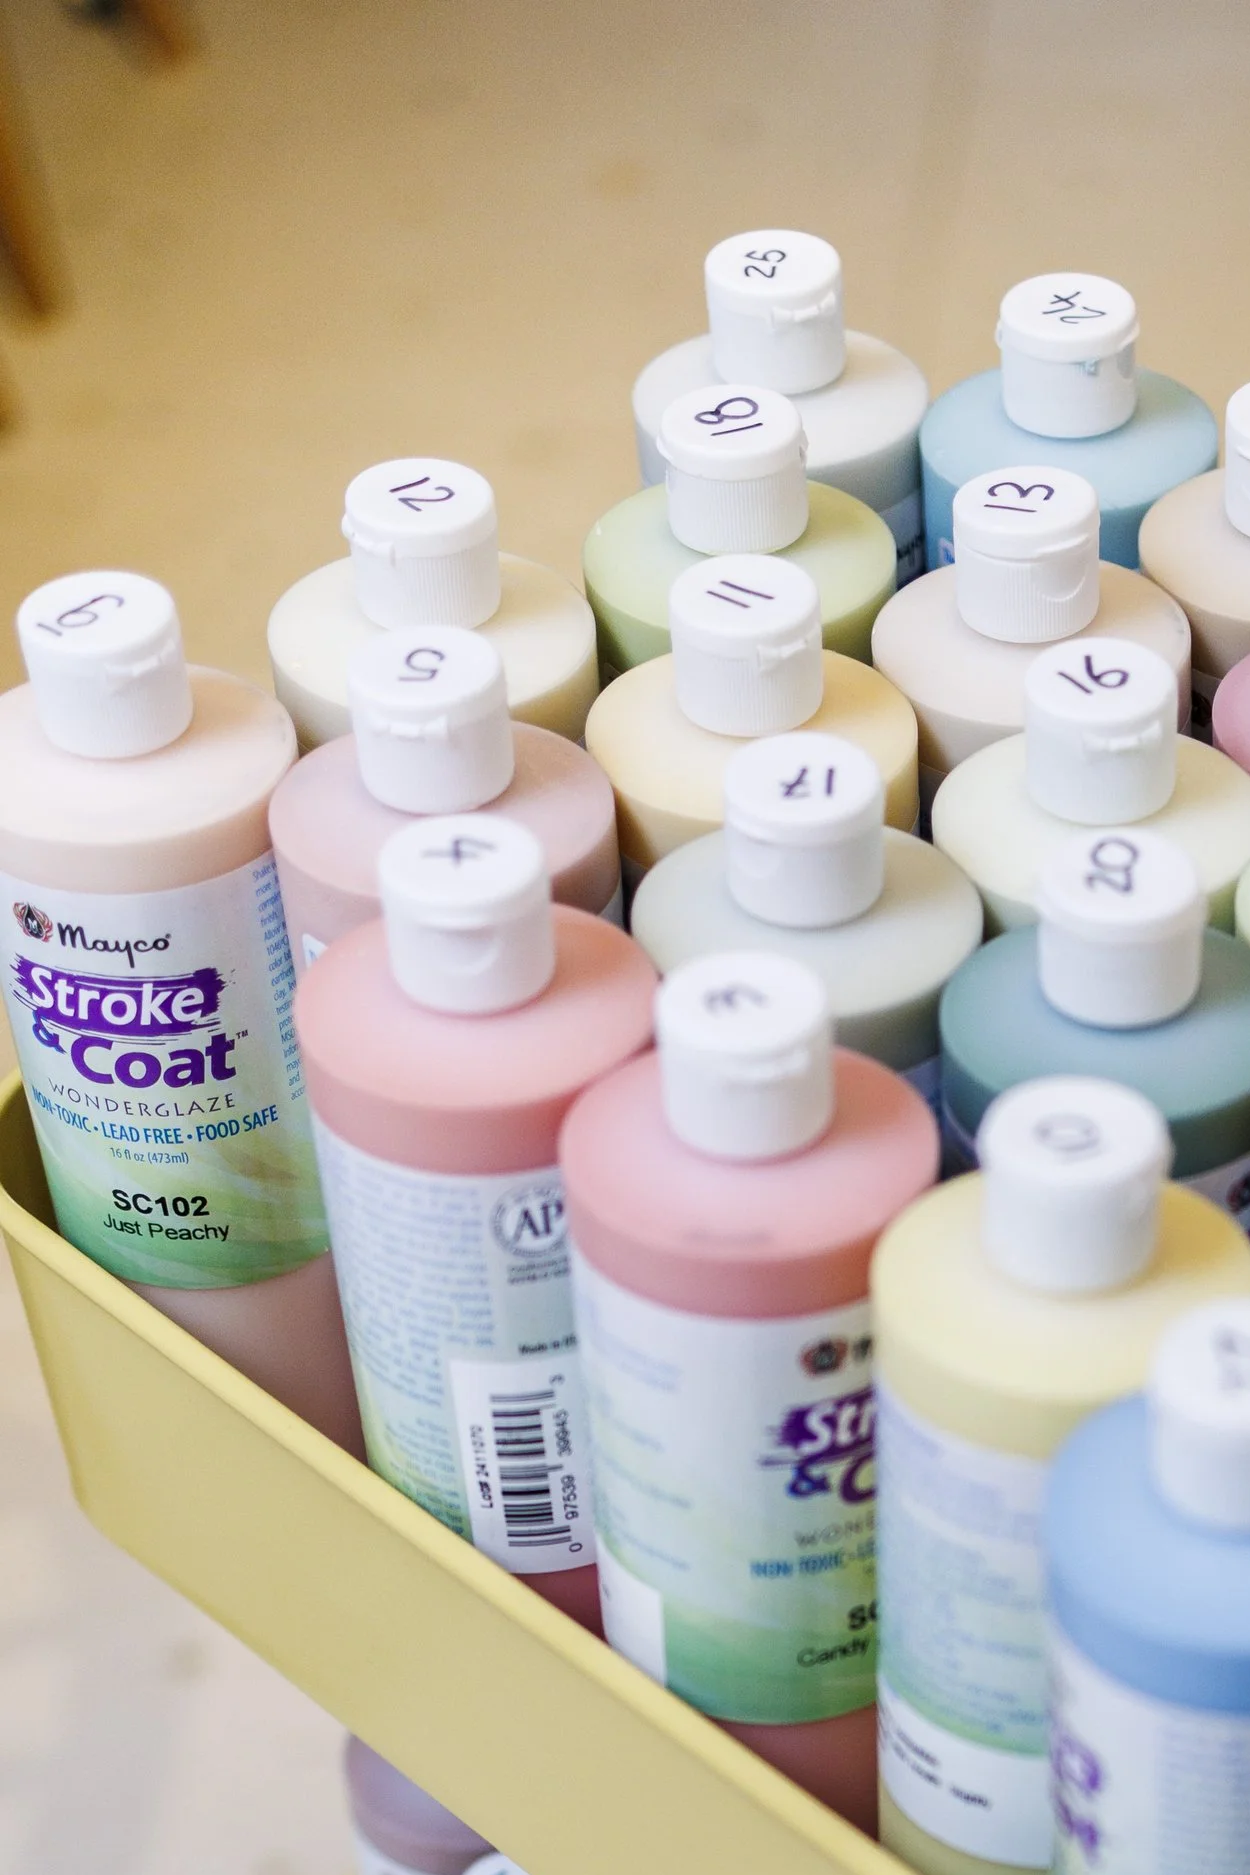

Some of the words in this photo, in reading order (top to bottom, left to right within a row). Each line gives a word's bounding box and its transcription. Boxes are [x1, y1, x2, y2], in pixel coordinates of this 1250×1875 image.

[744, 248, 787, 279] 25
[1042, 290, 1107, 324] 24
[695, 396, 763, 436] 18
[389, 476, 455, 512] 12
[984, 481, 1055, 513] 13
[706, 580, 775, 609] 11
[397, 647, 446, 683] 5
[1057, 654, 1129, 695] 16
[778, 765, 837, 798] 17
[421, 833, 497, 870] 4
[1085, 836, 1140, 893] 20
[56, 922, 171, 968] Mayco
[30, 966, 206, 1028] Stroke
[33, 1012, 67, 1054] &
[70, 1030, 238, 1089] Coat
[31, 1085, 92, 1132] NON-TOXIC
[102, 1121, 140, 1144] LEAD
[144, 1128, 184, 1145] FREE
[197, 1118, 240, 1142] FOOD
[244, 1104, 279, 1132] SAFE
[48, 1077, 236, 1118] WONDERGLAZE
[110, 1147, 122, 1159] 16
[124, 1148, 131, 1160] fl
[134, 1153, 144, 1162] oz
[148, 1152, 189, 1165] (473ml)
[111, 1189, 210, 1218] SC102
[102, 1213, 143, 1237] Just
[148, 1221, 230, 1242] Peachy
[511, 1198, 565, 1246] AP
[800, 1402, 875, 1456] Str
[569, 1541, 583, 1553] 0
[796, 1637, 871, 1668] Candy
